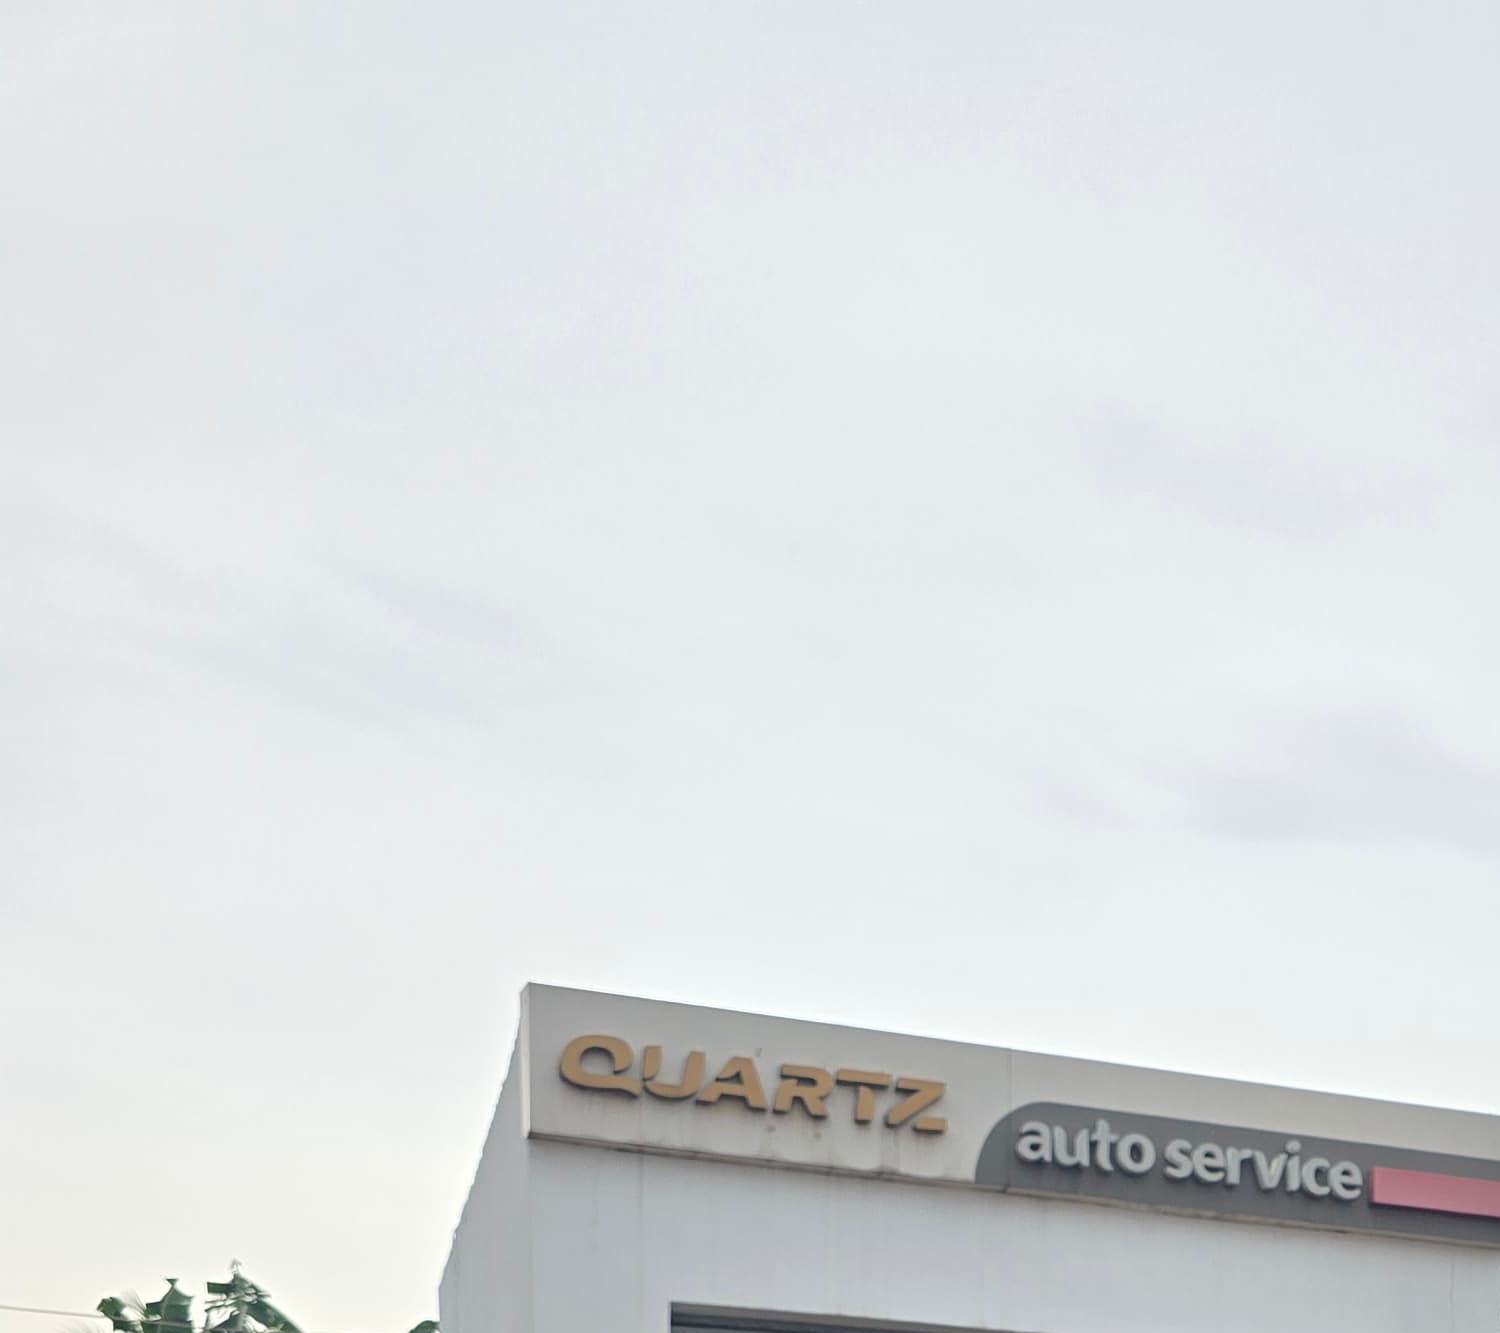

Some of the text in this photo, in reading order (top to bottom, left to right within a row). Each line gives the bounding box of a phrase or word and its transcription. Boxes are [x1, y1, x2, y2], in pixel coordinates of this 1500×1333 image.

[560, 1034, 946, 1134] QUARTZ
[1015, 1119, 1364, 1199] auto service
